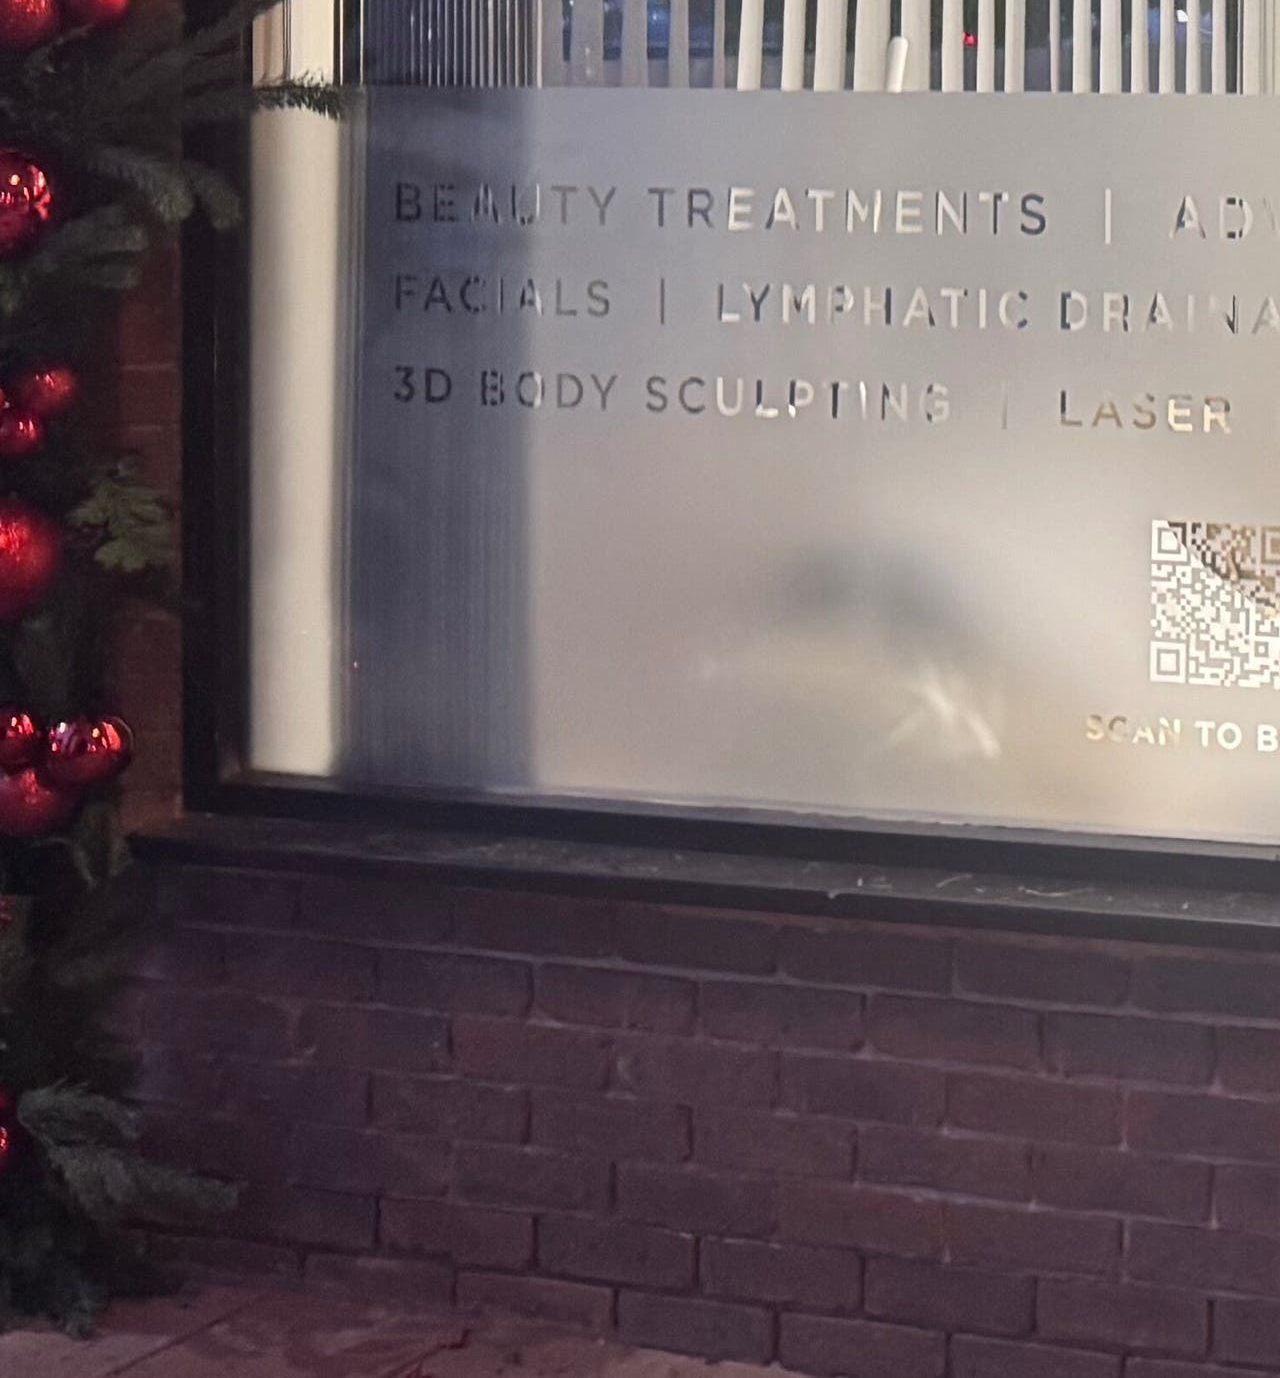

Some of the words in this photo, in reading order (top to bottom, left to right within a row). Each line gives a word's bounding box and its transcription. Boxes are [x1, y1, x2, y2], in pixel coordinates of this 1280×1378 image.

[395, 182, 617, 225] BEAUTY
[648, 187, 1047, 236] TREATMENTS
[394, 274, 611, 317] FACIALS
[717, 282, 1029, 330] LYMPHATIC
[393, 366, 452, 405] 3D
[479, 371, 618, 413] BODY
[645, 376, 952, 424] SCULPTING
[1060, 390, 1232, 434] LASER
[1085, 714, 1181, 747] SCAN
[1194, 720, 1243, 750] TO
